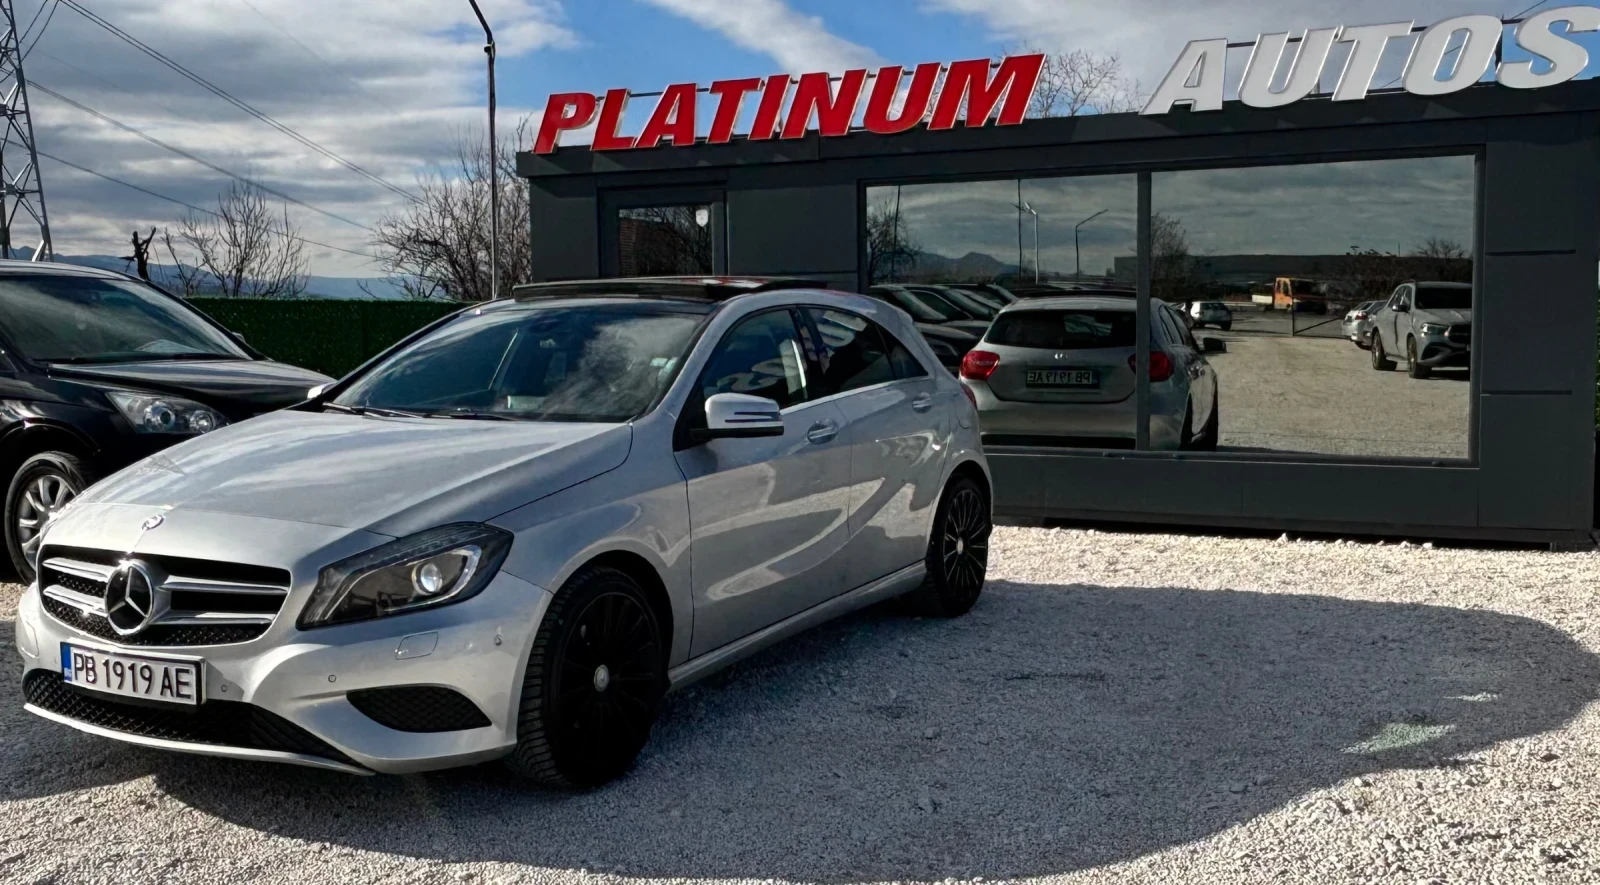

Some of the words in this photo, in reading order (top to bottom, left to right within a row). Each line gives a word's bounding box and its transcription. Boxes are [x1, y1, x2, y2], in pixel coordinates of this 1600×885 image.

[532, 53, 1047, 155] PLATINUM
[1138, 5, 1600, 116] AUTOS
[74, 652, 97, 684] PB
[102, 658, 154, 694] 1919
[160, 666, 192, 699] AE
